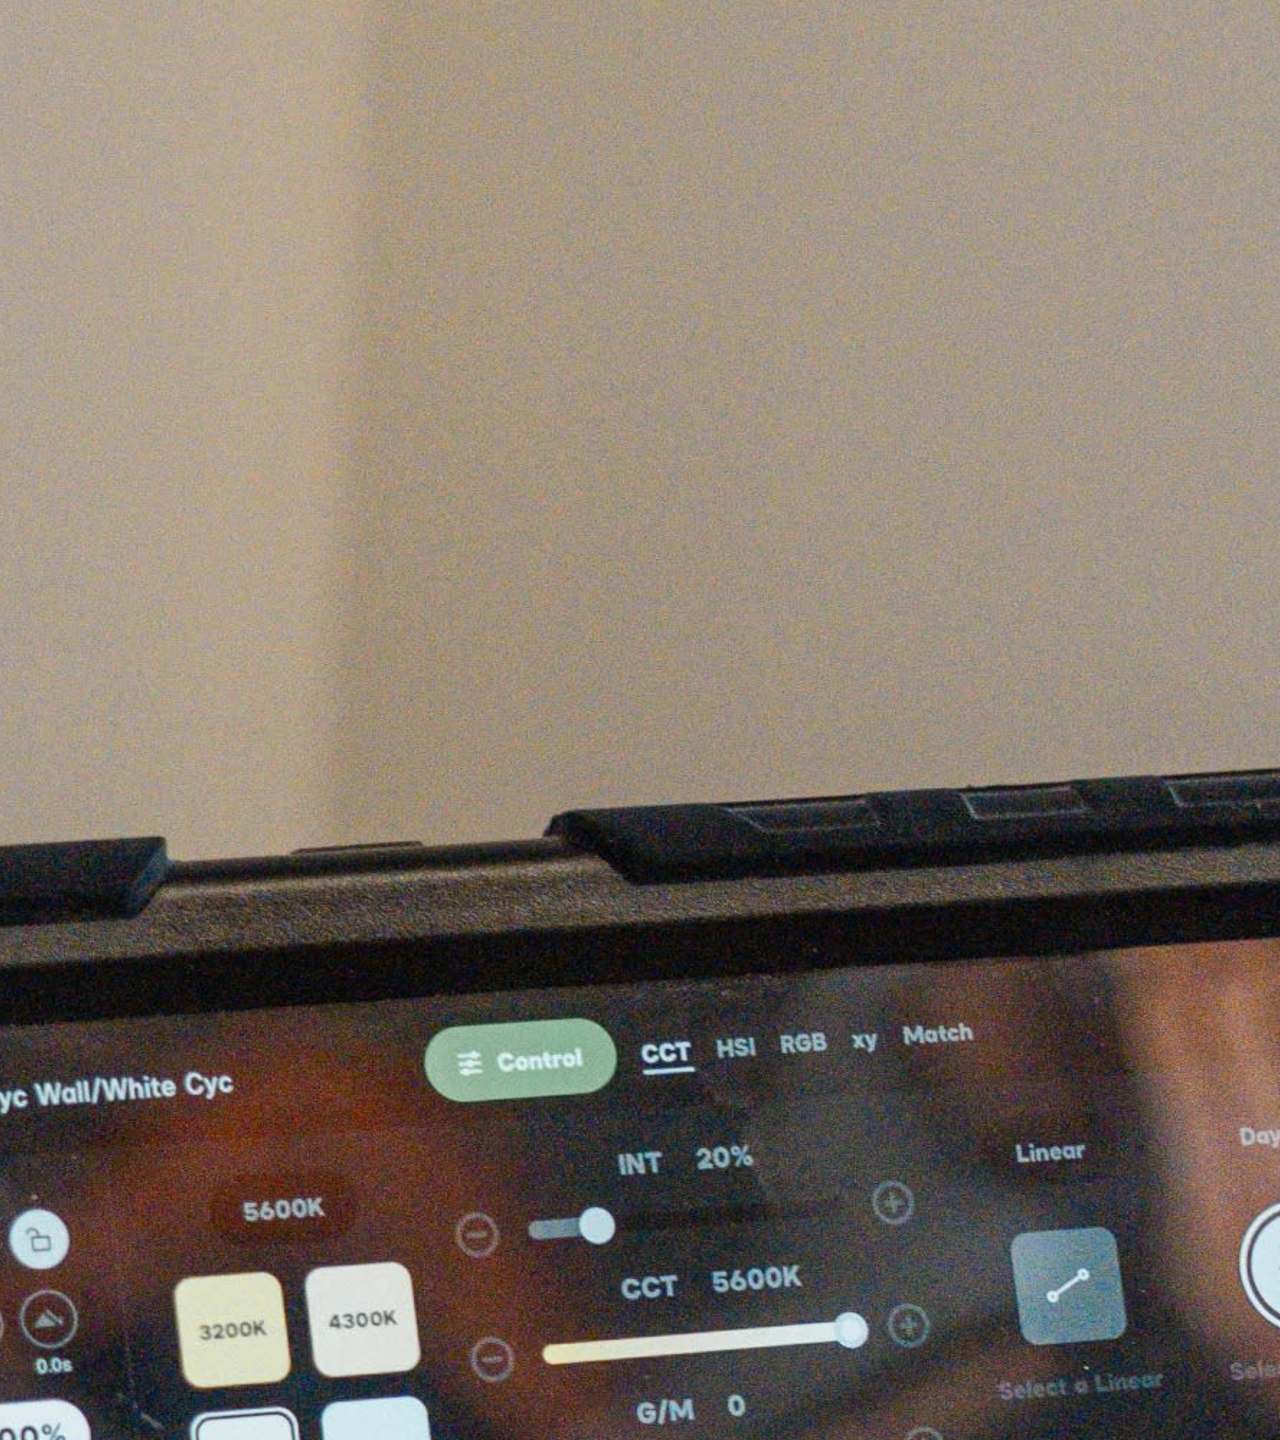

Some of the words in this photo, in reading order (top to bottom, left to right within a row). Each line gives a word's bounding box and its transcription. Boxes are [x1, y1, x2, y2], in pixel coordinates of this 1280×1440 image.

[642, 1042, 691, 1063] CCT
[716, 1037, 755, 1058] HSI
[781, 1033, 827, 1053] RGB
[853, 1033, 878, 1051] xy
[903, 1023, 973, 1044] Match
[497, 1049, 582, 1072] Control
[35, 1076, 176, 1106] Wall/White
[185, 1072, 234, 1097] Cyc
[618, 1151, 662, 1176] INT
[696, 1146, 753, 1170] 20%
[1016, 1143, 1085, 1163] Linear
[243, 1197, 326, 1223] 5600K
[622, 1276, 678, 1300] CCT
[712, 1266, 802, 1293] 5600K
[200, 1321, 267, 1340] 3200K
[328, 1311, 397, 1329] 4300K
[37, 1357, 73, 1373] 0.0s
[999, 1380, 1069, 1400] Select
[1076, 1381, 1088, 1394] a
[1095, 1372, 1163, 1392] Linear
[636, 1399, 694, 1425] G/M
[728, 1395, 745, 1416] 0
